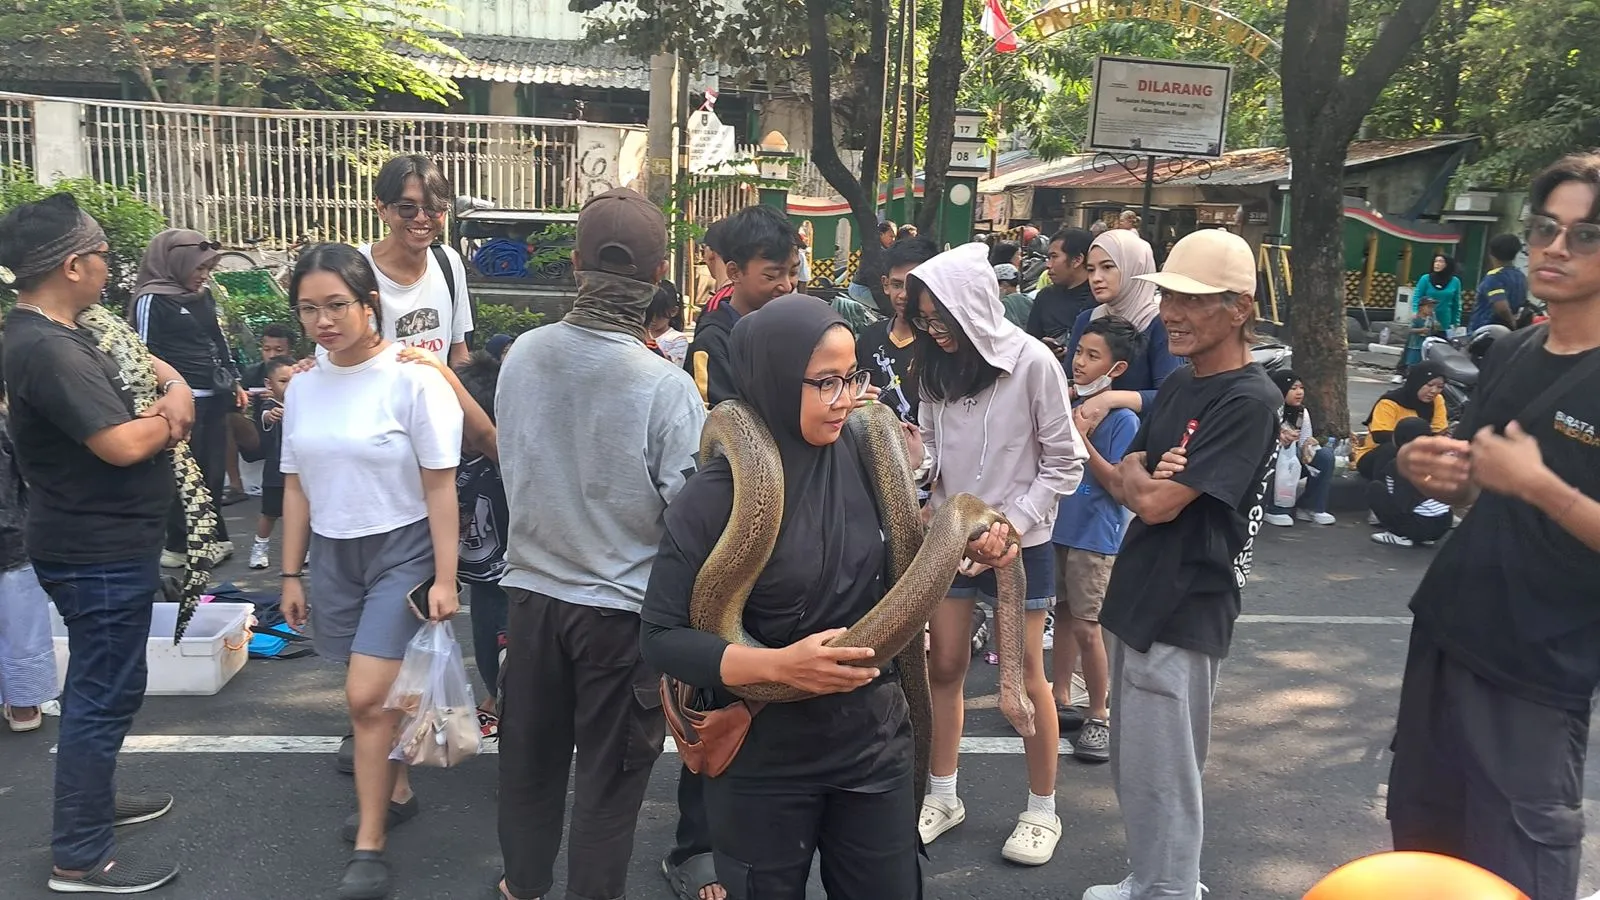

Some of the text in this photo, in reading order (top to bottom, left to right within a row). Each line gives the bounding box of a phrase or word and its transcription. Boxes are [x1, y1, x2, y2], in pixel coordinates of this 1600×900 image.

[1137, 79, 1213, 97] DILARANG
[960, 125, 970, 134] 17
[956, 151, 969, 161] 08
